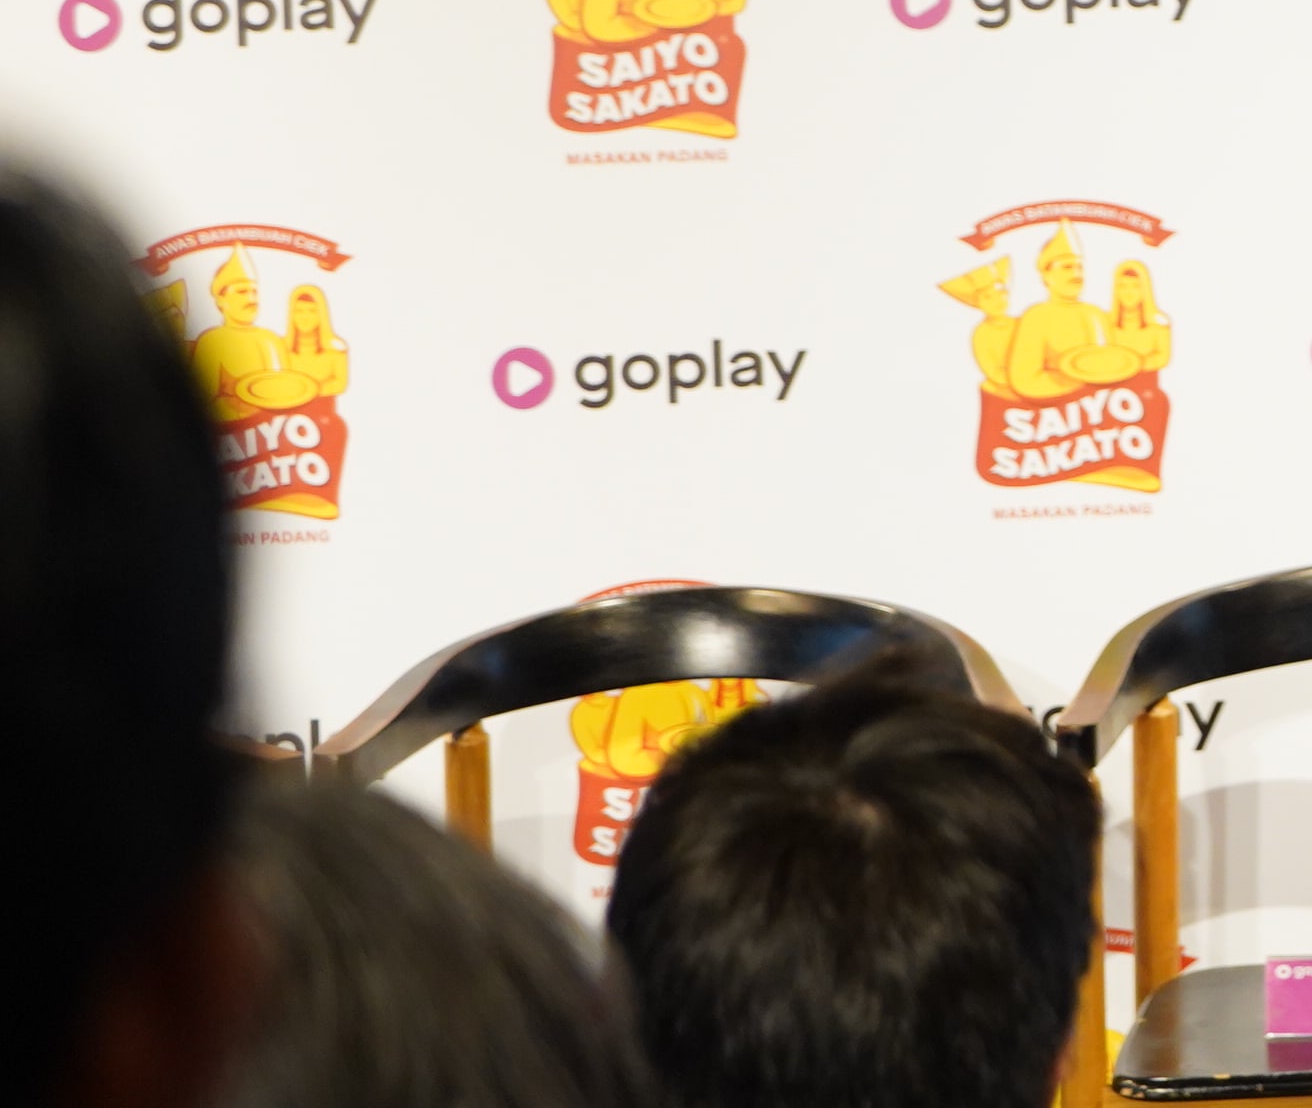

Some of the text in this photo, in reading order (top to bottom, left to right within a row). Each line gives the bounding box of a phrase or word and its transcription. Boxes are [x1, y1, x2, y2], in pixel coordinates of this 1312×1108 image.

[578, 32, 719, 88] SAIYO
[565, 70, 728, 124] SAKATO
[574, 339, 806, 409] goplay
[219, 414, 321, 462] AIYO
[1004, 387, 1144, 443] SAIYO
[225, 452, 331, 497] KATO
[992, 424, 1153, 479] SAKATO
